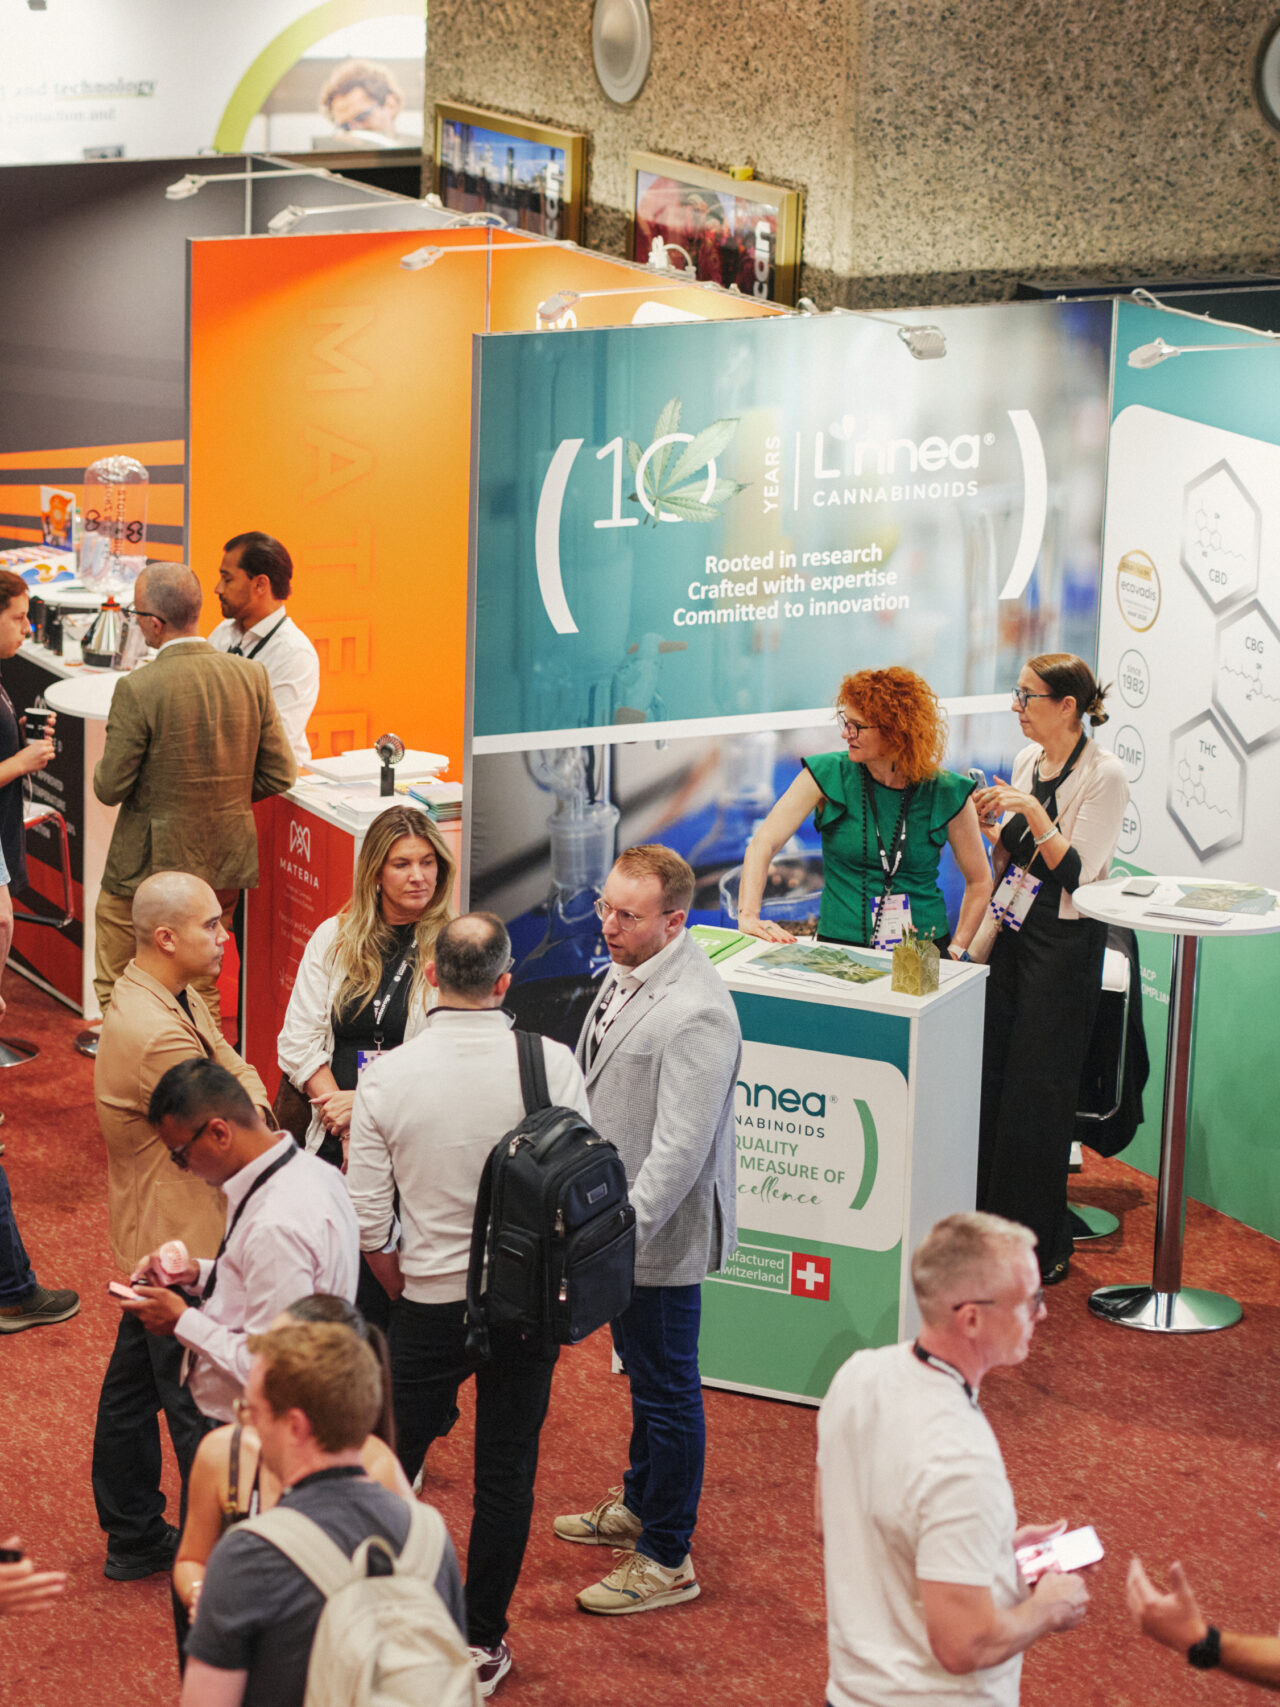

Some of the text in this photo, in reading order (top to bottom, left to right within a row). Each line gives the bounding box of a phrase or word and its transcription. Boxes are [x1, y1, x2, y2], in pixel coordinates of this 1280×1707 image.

[52, 76, 158, 99] technology
[763, 435, 782, 514] YEARS
[812, 480, 979, 507] CANNABINOIDS
[704, 543, 883, 574] Rooted in research
[687, 568, 898, 600] Crafted with expertise
[1209, 568, 1228, 586] CBD
[1120, 580, 1157, 601] ecovadis
[672, 593, 911, 626] Committed to innovation
[1245, 636, 1265, 655] CBG
[1122, 673, 1145, 696] 1982
[1117, 743, 1142, 766] DMF
[1199, 738, 1217, 759] THC
[1122, 817, 1137, 836] EP
[279, 857, 320, 889] MATERIA
[736, 1080, 839, 1118] nnea®
[735, 1115, 826, 1139] NABINOIDS
[740, 1155, 846, 1184] MEASURE OF
[737, 1175, 823, 1206] cellence
[727, 1250, 785, 1270] ufactured
[722, 1264, 784, 1285] witzerland
